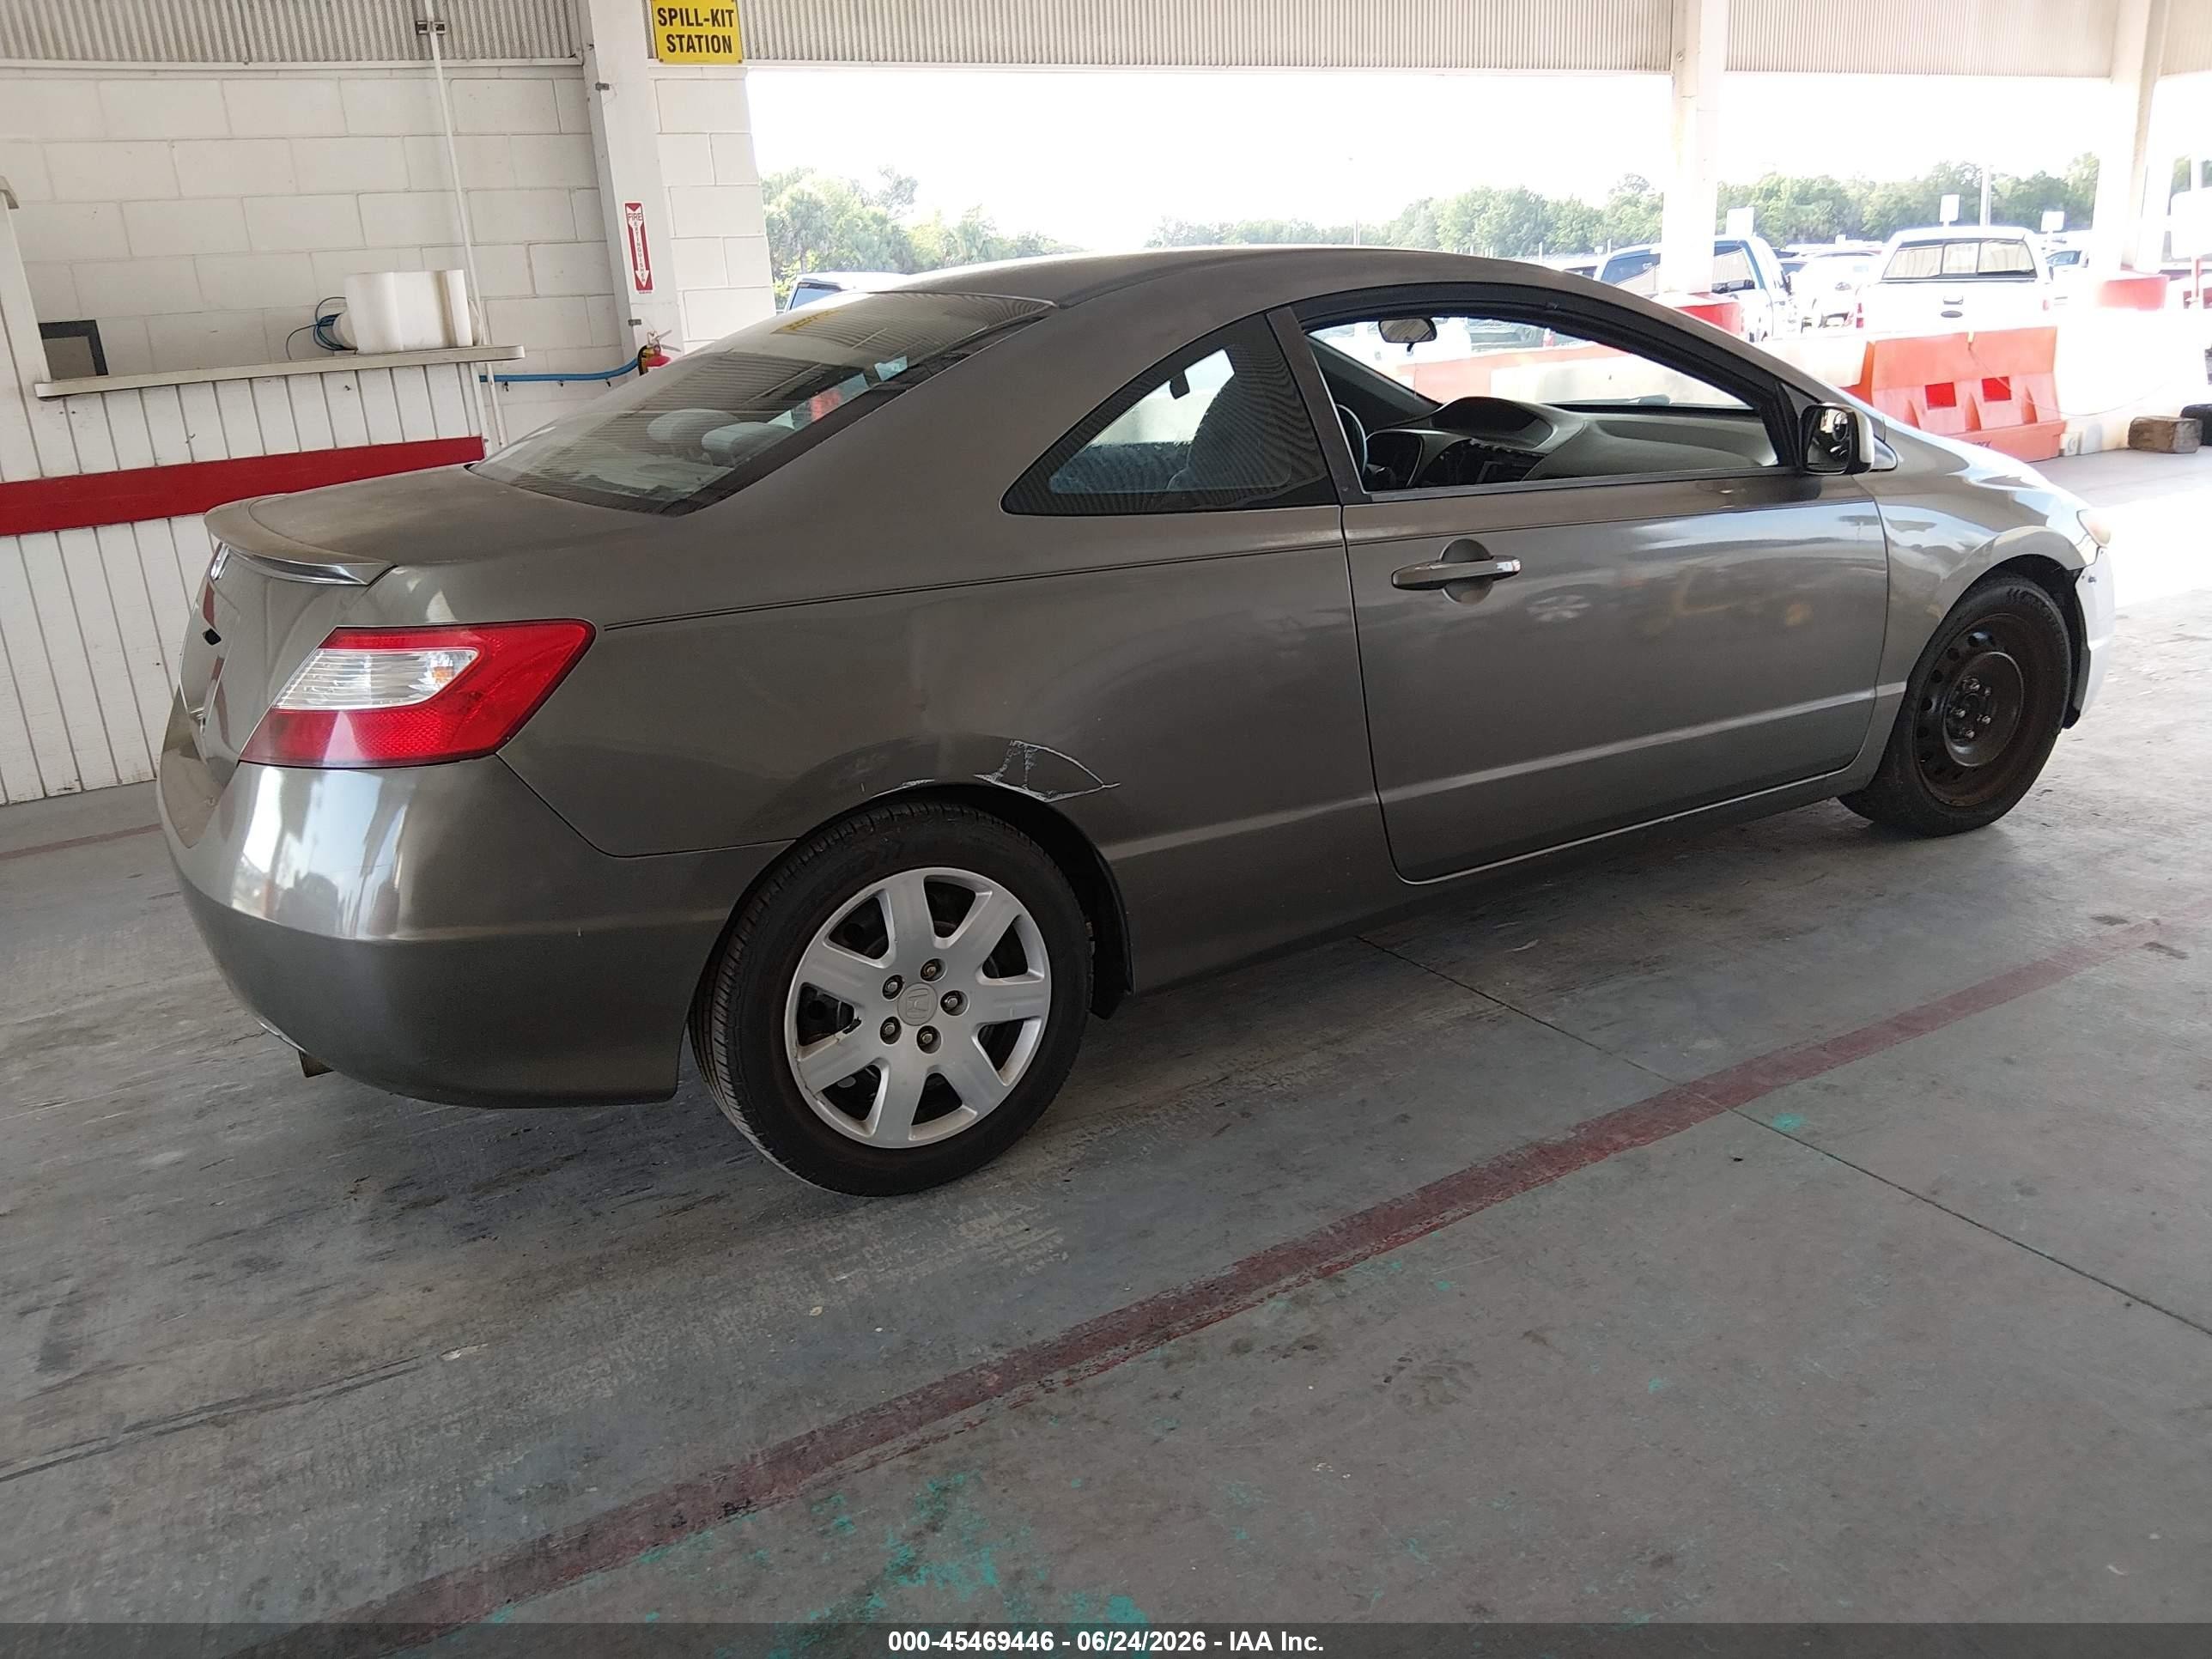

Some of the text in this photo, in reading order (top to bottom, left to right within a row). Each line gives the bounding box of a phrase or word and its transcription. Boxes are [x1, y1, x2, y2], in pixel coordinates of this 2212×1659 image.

[657, 7, 734, 27] SPILL-KIT
[665, 33, 732, 53] STATION
[628, 212, 643, 222] FIRE
[634, 222, 646, 283] EXTINGUISHER
